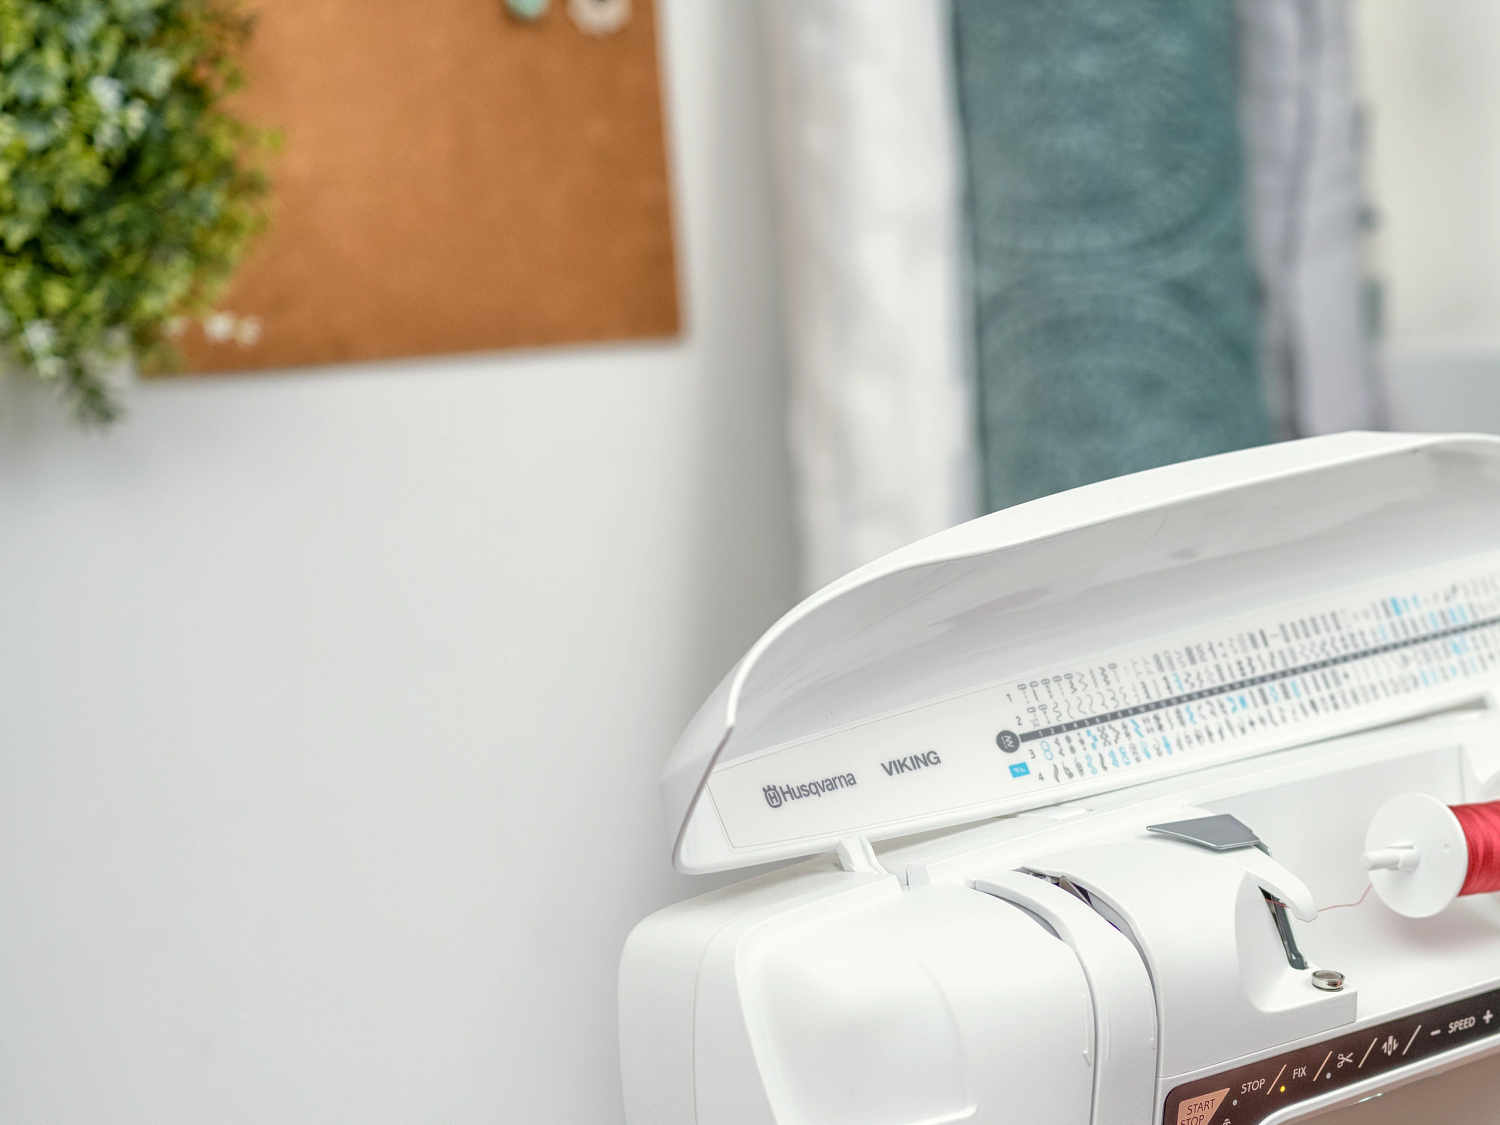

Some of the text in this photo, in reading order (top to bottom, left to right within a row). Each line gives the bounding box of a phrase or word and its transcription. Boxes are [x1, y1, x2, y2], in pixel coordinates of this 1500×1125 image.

[1015, 716, 1023, 726] 2
[1028, 749, 1036, 759] 3
[779, 772, 857, 802] Husqvarna
[880, 750, 942, 776] VIKING
[1038, 773, 1045, 782] 4
[1448, 1016, 1476, 1034] SPEED
[1292, 1066, 1307, 1079] FIX
[1241, 1078, 1266, 1094] STOP
[1187, 1099, 1216, 1116] START
